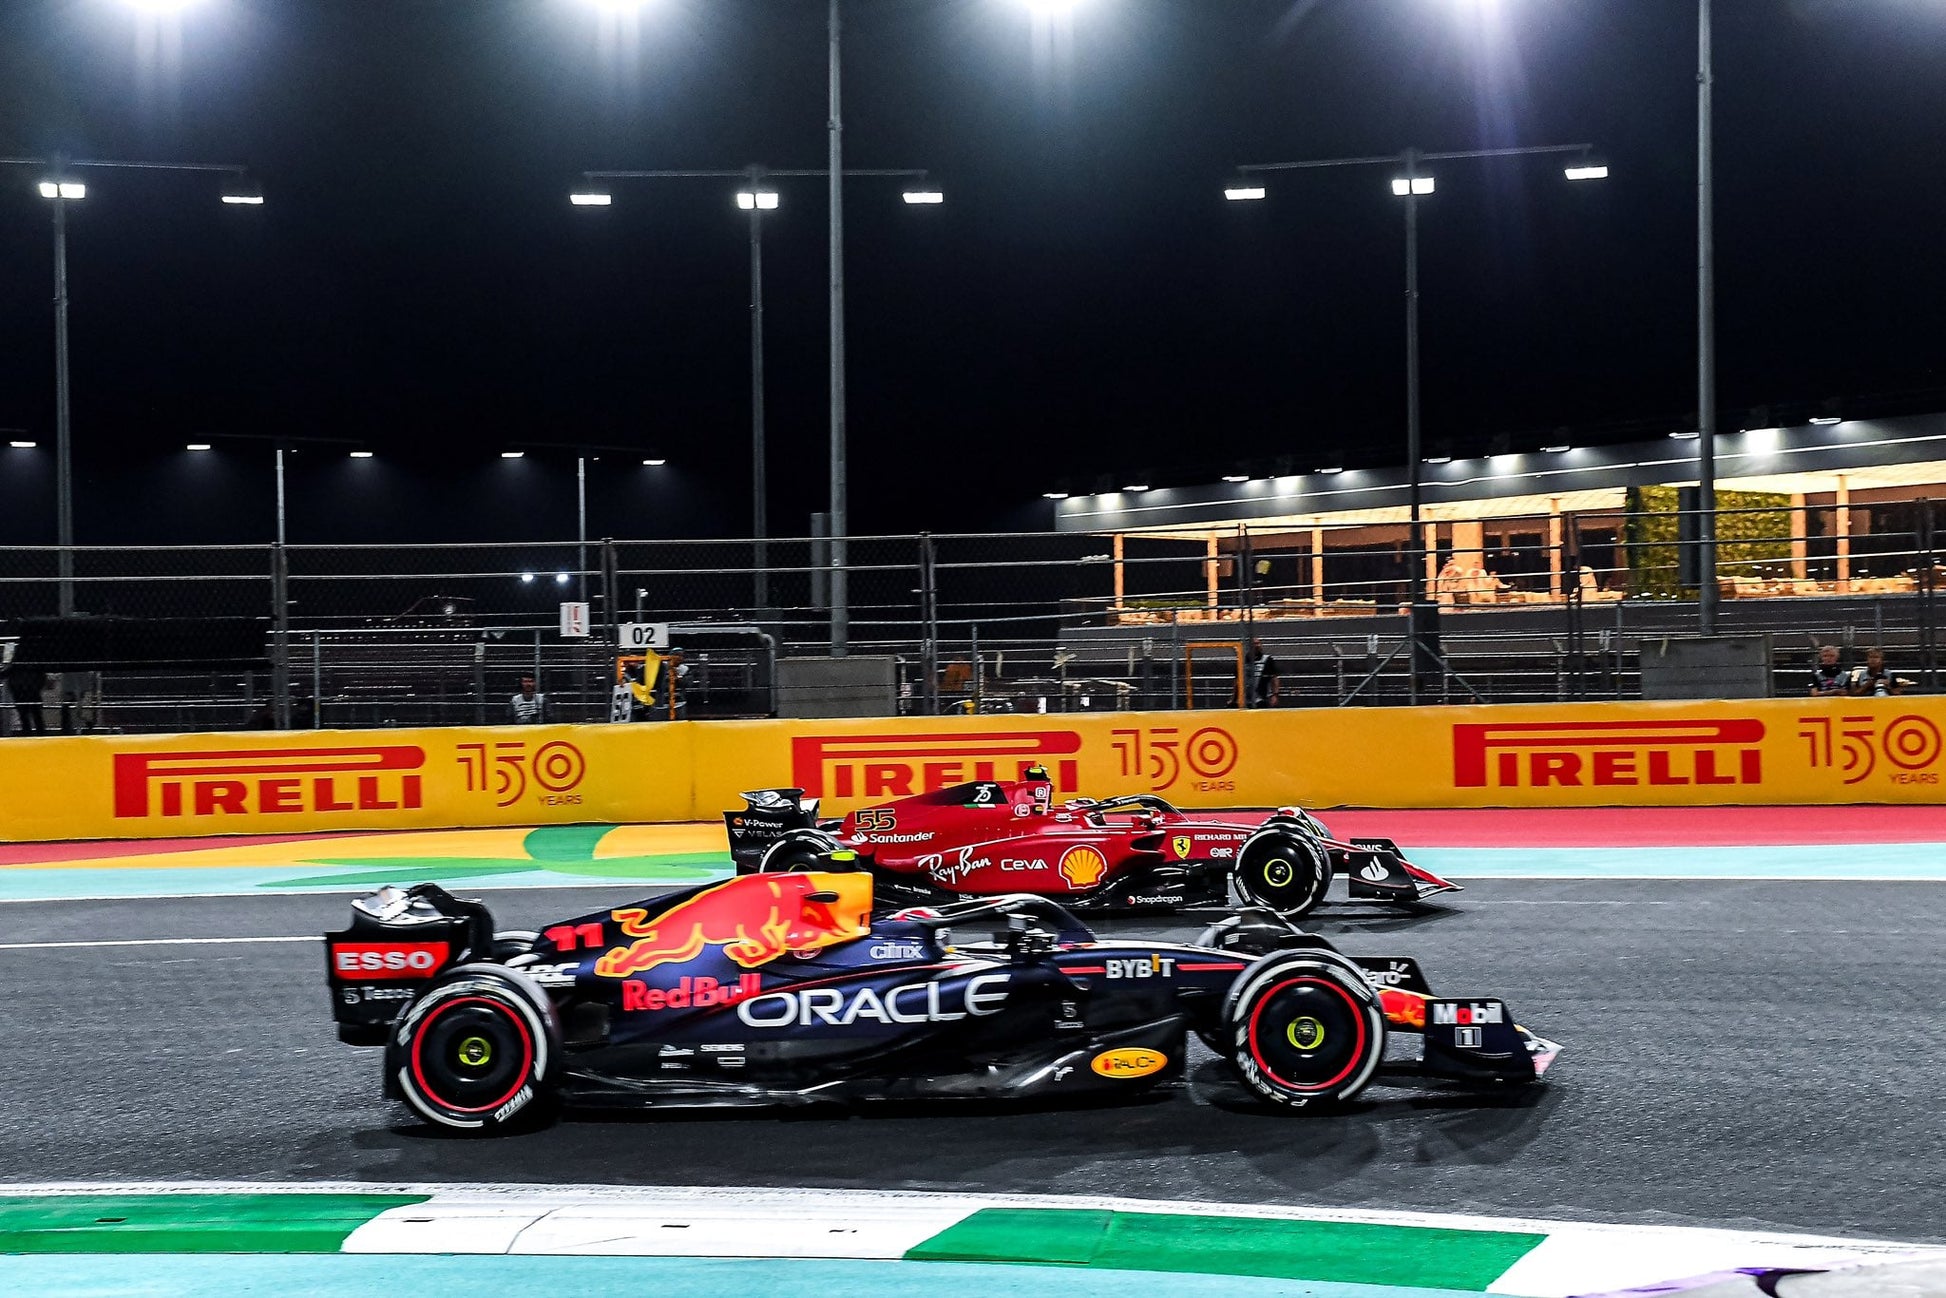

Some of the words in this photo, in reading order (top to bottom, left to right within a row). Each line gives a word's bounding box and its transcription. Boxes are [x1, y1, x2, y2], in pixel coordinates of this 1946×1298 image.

[633, 627, 656, 644] 02
[1453, 719, 1766, 788] PIRELLI
[1799, 714, 1942, 785] 150
[1111, 727, 1239, 792] 150
[114, 746, 426, 818] PIRELLI
[457, 741, 587, 807] 150
[1888, 772, 1940, 785] YEARS
[1190, 781, 1236, 792] YEARS
[537, 794, 583, 806] YEARS
[744, 818, 784, 829] V-Power
[855, 809, 897, 832] 55
[869, 831, 935, 844] Santander
[1194, 833, 1232, 841] RICHARD
[1136, 895, 1183, 905] Snapdragon
[544, 923, 604, 951] 11
[336, 951, 435, 970] ESSO
[737, 974, 1011, 1028] ORACLE
